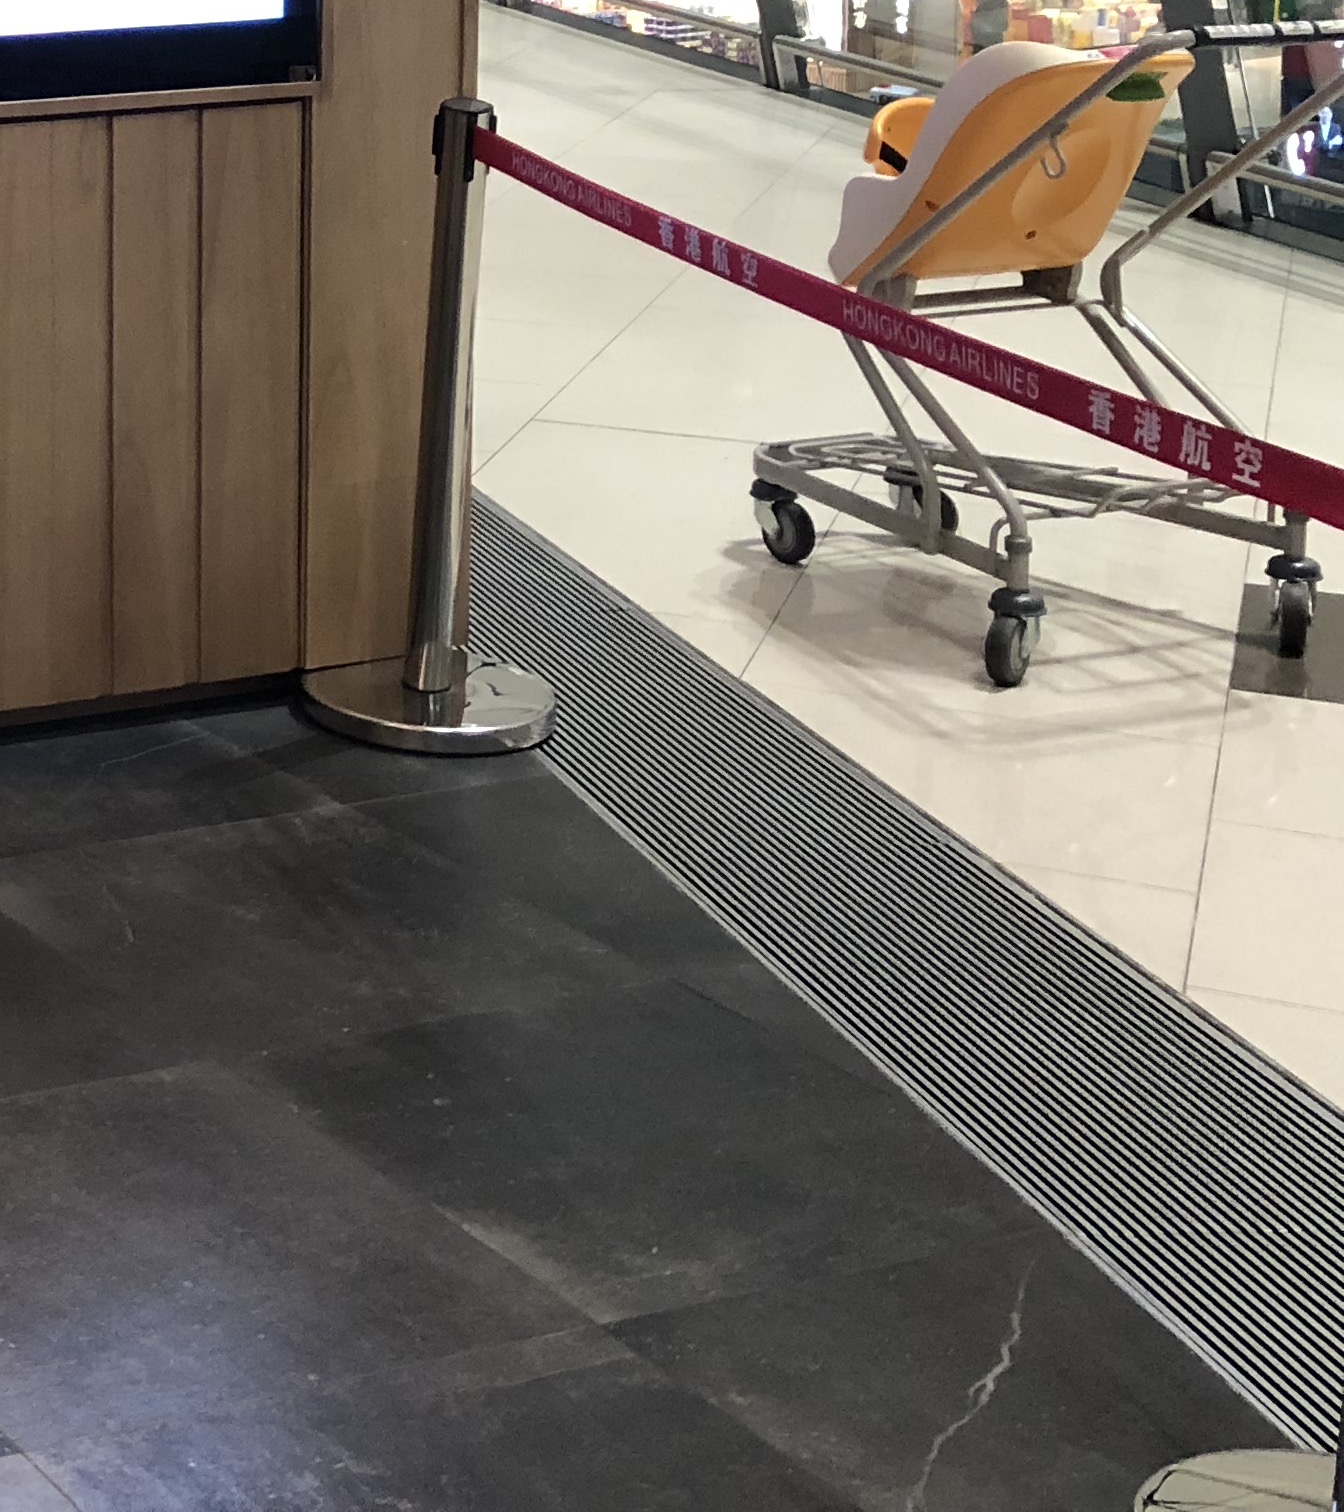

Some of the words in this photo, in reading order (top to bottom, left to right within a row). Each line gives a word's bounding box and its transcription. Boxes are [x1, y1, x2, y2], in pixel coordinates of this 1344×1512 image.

[949, 338, 1040, 401] AIRLINES
[1088, 389, 1263, 488] 香港航空
